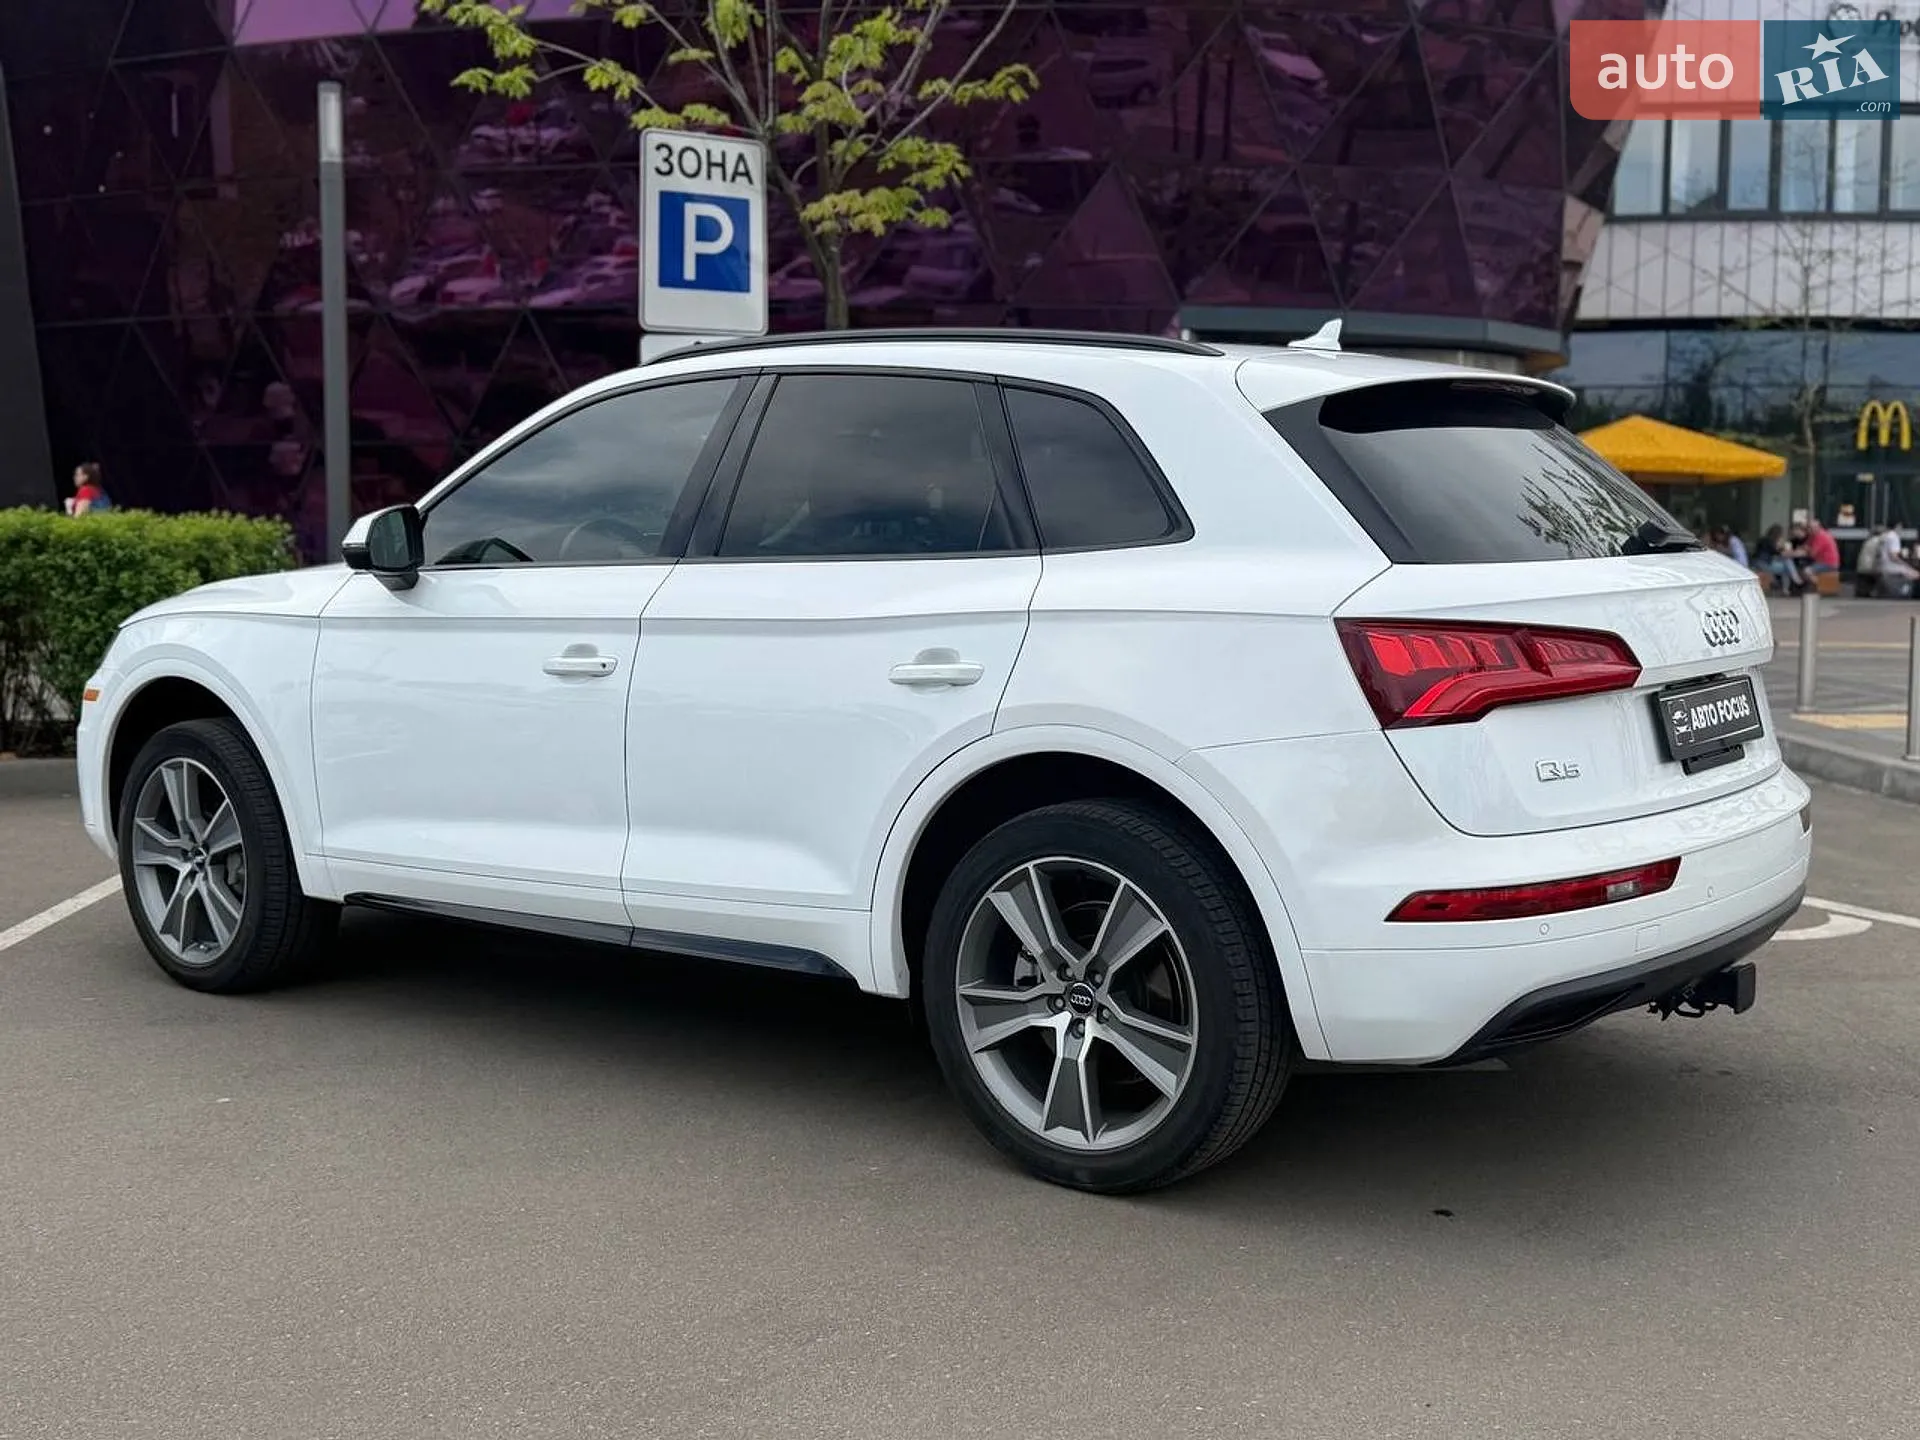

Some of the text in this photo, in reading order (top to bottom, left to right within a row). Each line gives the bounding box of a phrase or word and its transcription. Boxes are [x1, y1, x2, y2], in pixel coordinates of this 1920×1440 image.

[654, 143, 754, 186] ЗОНА
[682, 201, 735, 282] P
[1716, 694, 1750, 723] FOCUS
[1535, 760, 1581, 783] Q5
